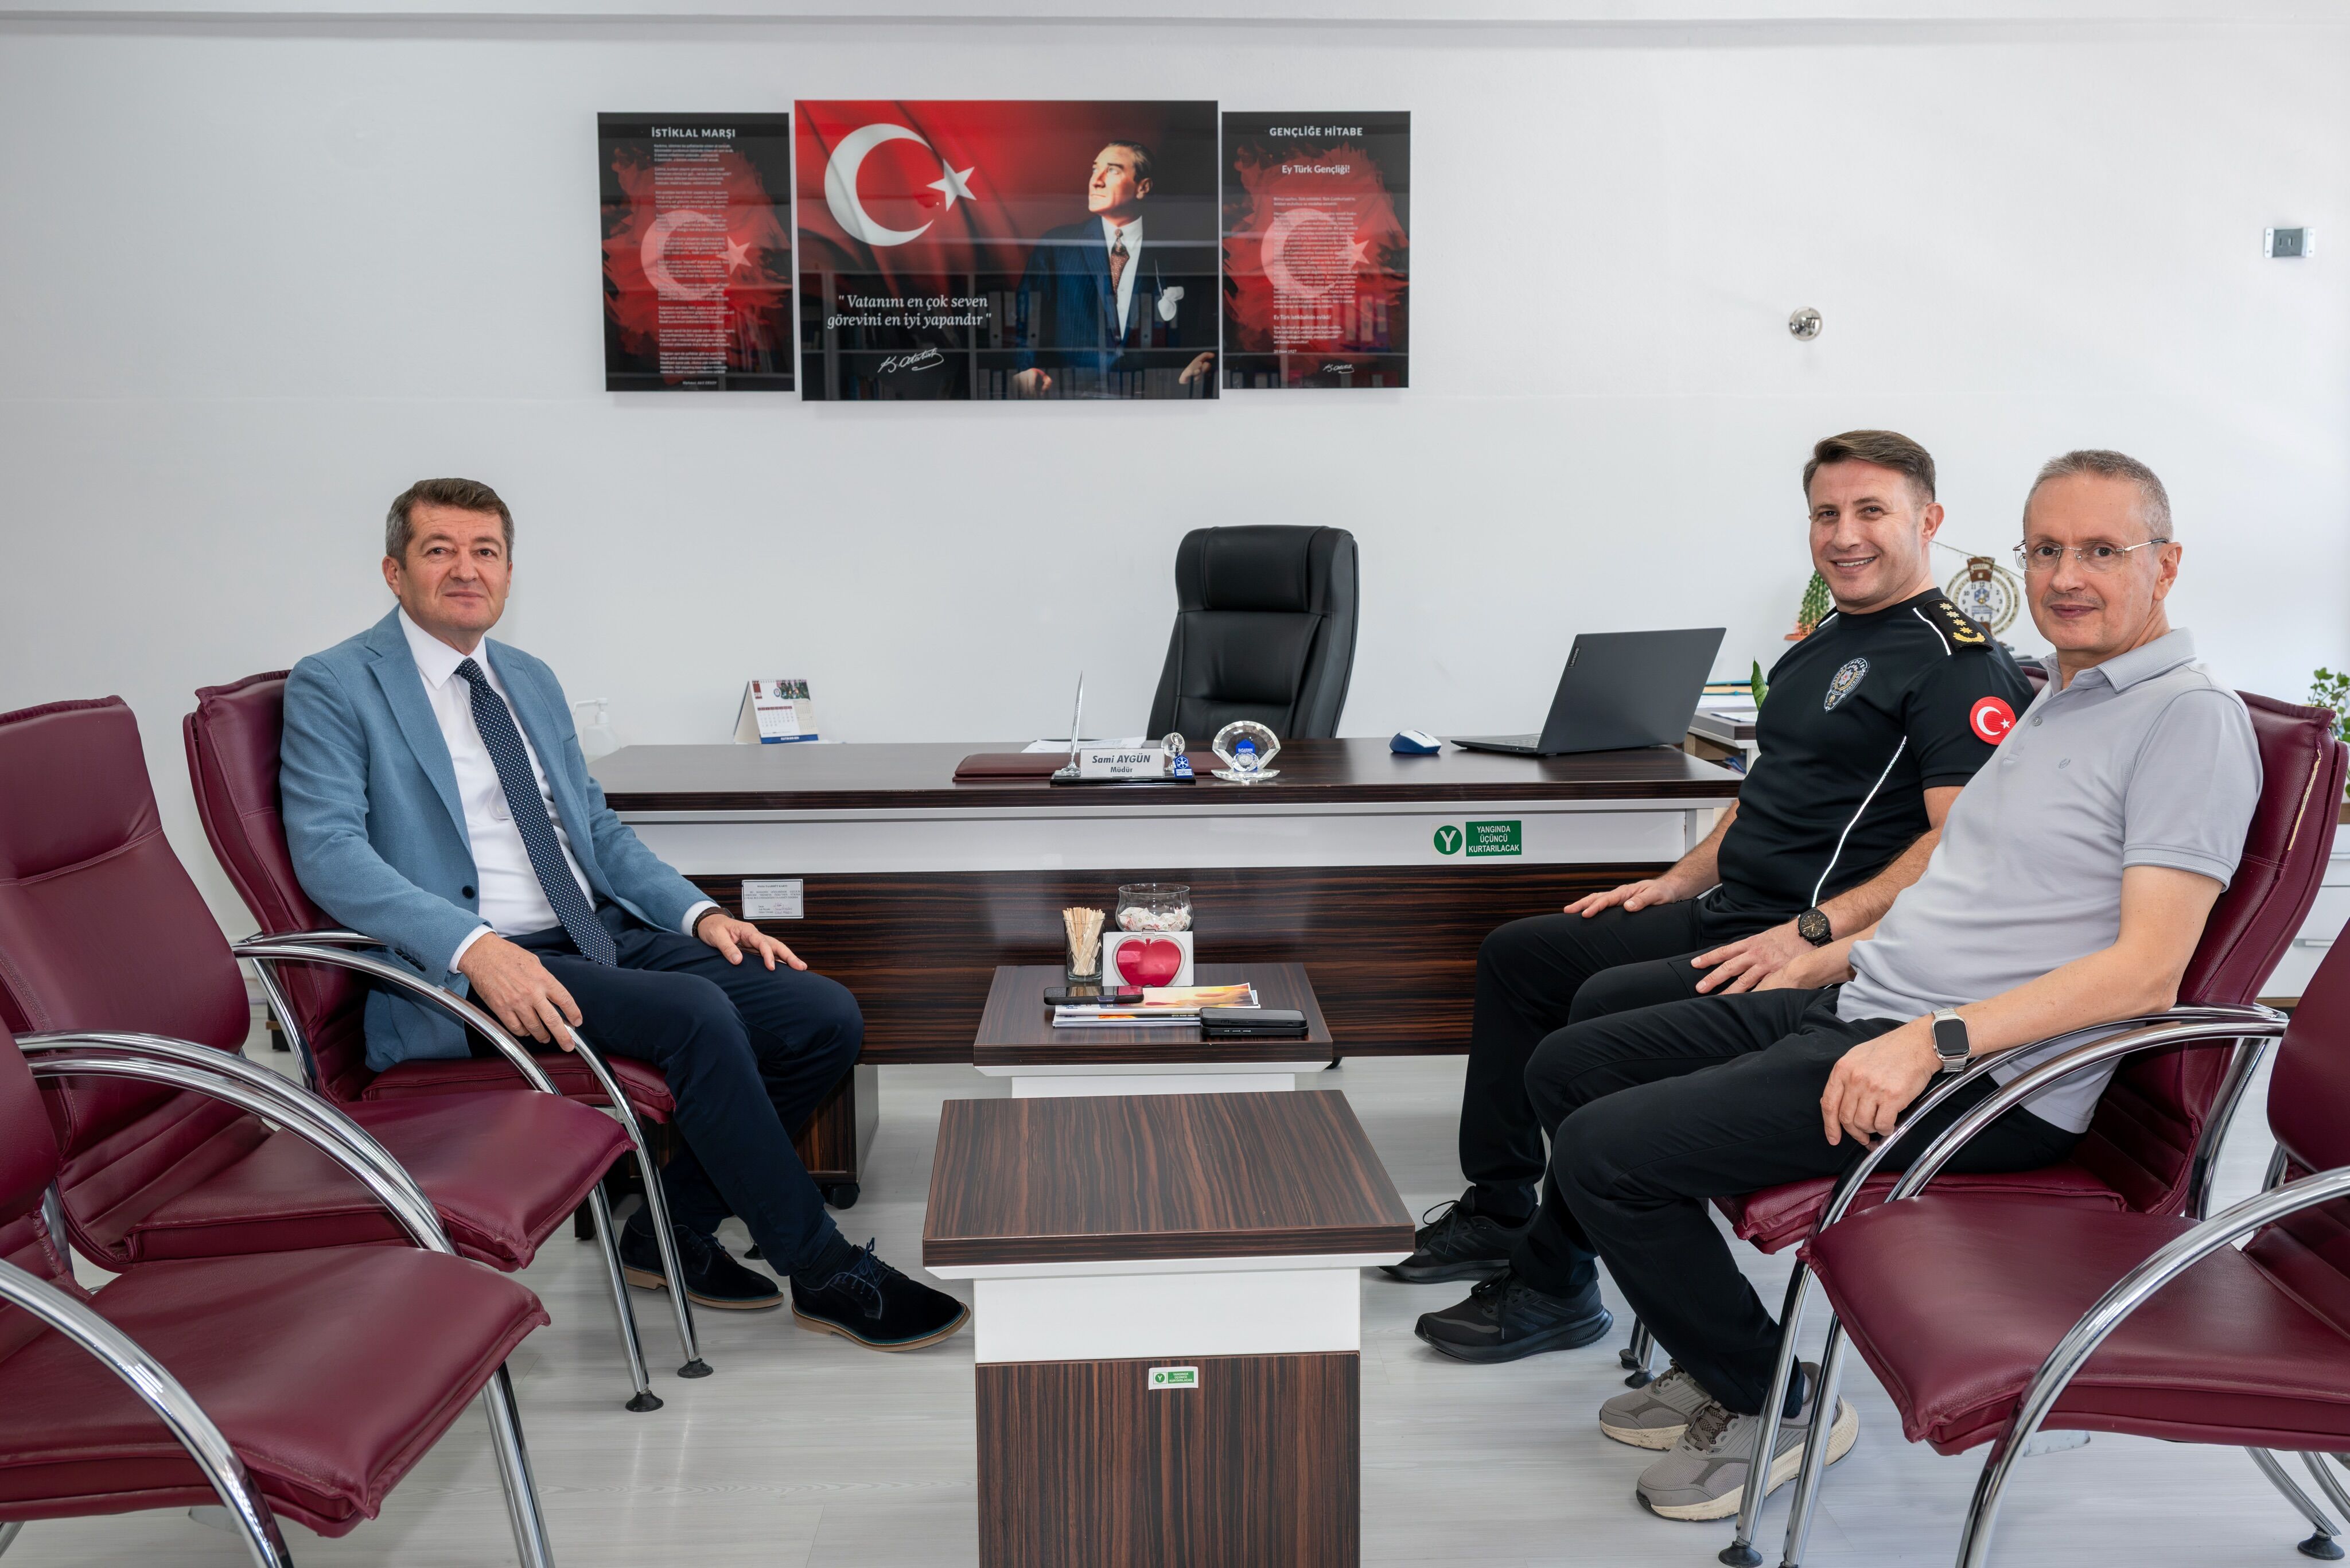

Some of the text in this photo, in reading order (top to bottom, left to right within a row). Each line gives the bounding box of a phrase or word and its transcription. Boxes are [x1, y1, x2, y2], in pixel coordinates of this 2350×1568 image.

[651, 127, 736, 139] İSTİKLAL MARŞI
[1269, 126, 1363, 138] GENÇLİĞE HİTABE
[1282, 165, 1350, 175] Ey Türk Gençliği!
[847, 295, 904, 308] Vatanını
[907, 298, 923, 308] en
[926, 295, 948, 310] çok
[951, 298, 988, 308] seven
[827, 313, 882, 329] görevini
[885, 317, 901, 326] en
[904, 313, 921, 329] iyi
[923, 313, 983, 329] yapandır
[1570, 648, 1579, 666] Lenovo
[1850, 660, 1865, 668] POLİS
[1092, 754, 1151, 763] Sami AYGÜN
[1439, 830, 1457, 851] Y
[1480, 834, 1508, 844] ÜÇÜNCÜ
[1469, 845, 1519, 853] KURTARILACAK
